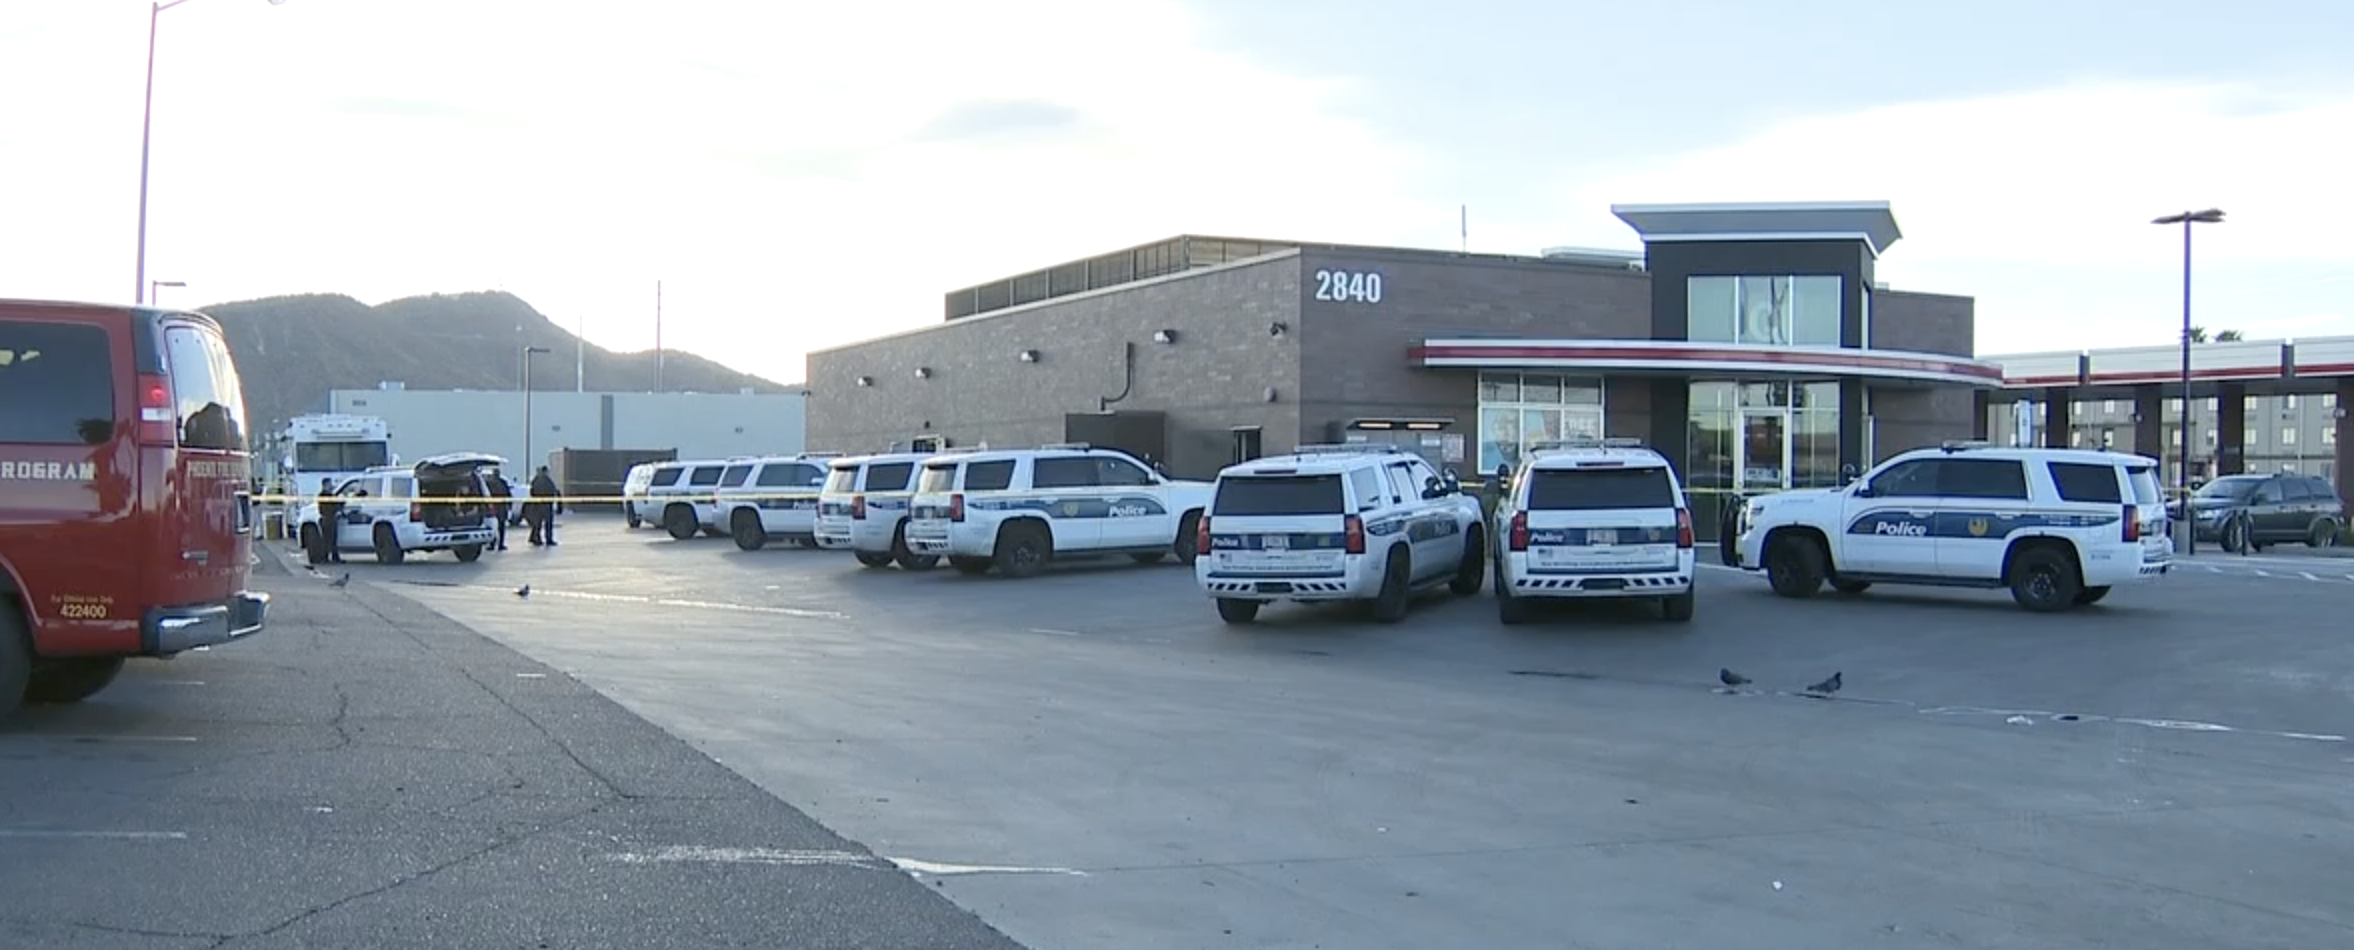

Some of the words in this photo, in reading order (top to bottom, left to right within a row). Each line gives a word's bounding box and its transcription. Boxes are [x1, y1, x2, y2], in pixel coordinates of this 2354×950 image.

[1316, 270, 1381, 303] 2840
[1, 461, 97, 479] ROGRAM
[1109, 505, 1147, 518] Police
[1876, 521, 1927, 536] Police
[1211, 537, 1239, 547] Police
[1530, 530, 1565, 543] Police
[60, 604, 107, 618] 422400
